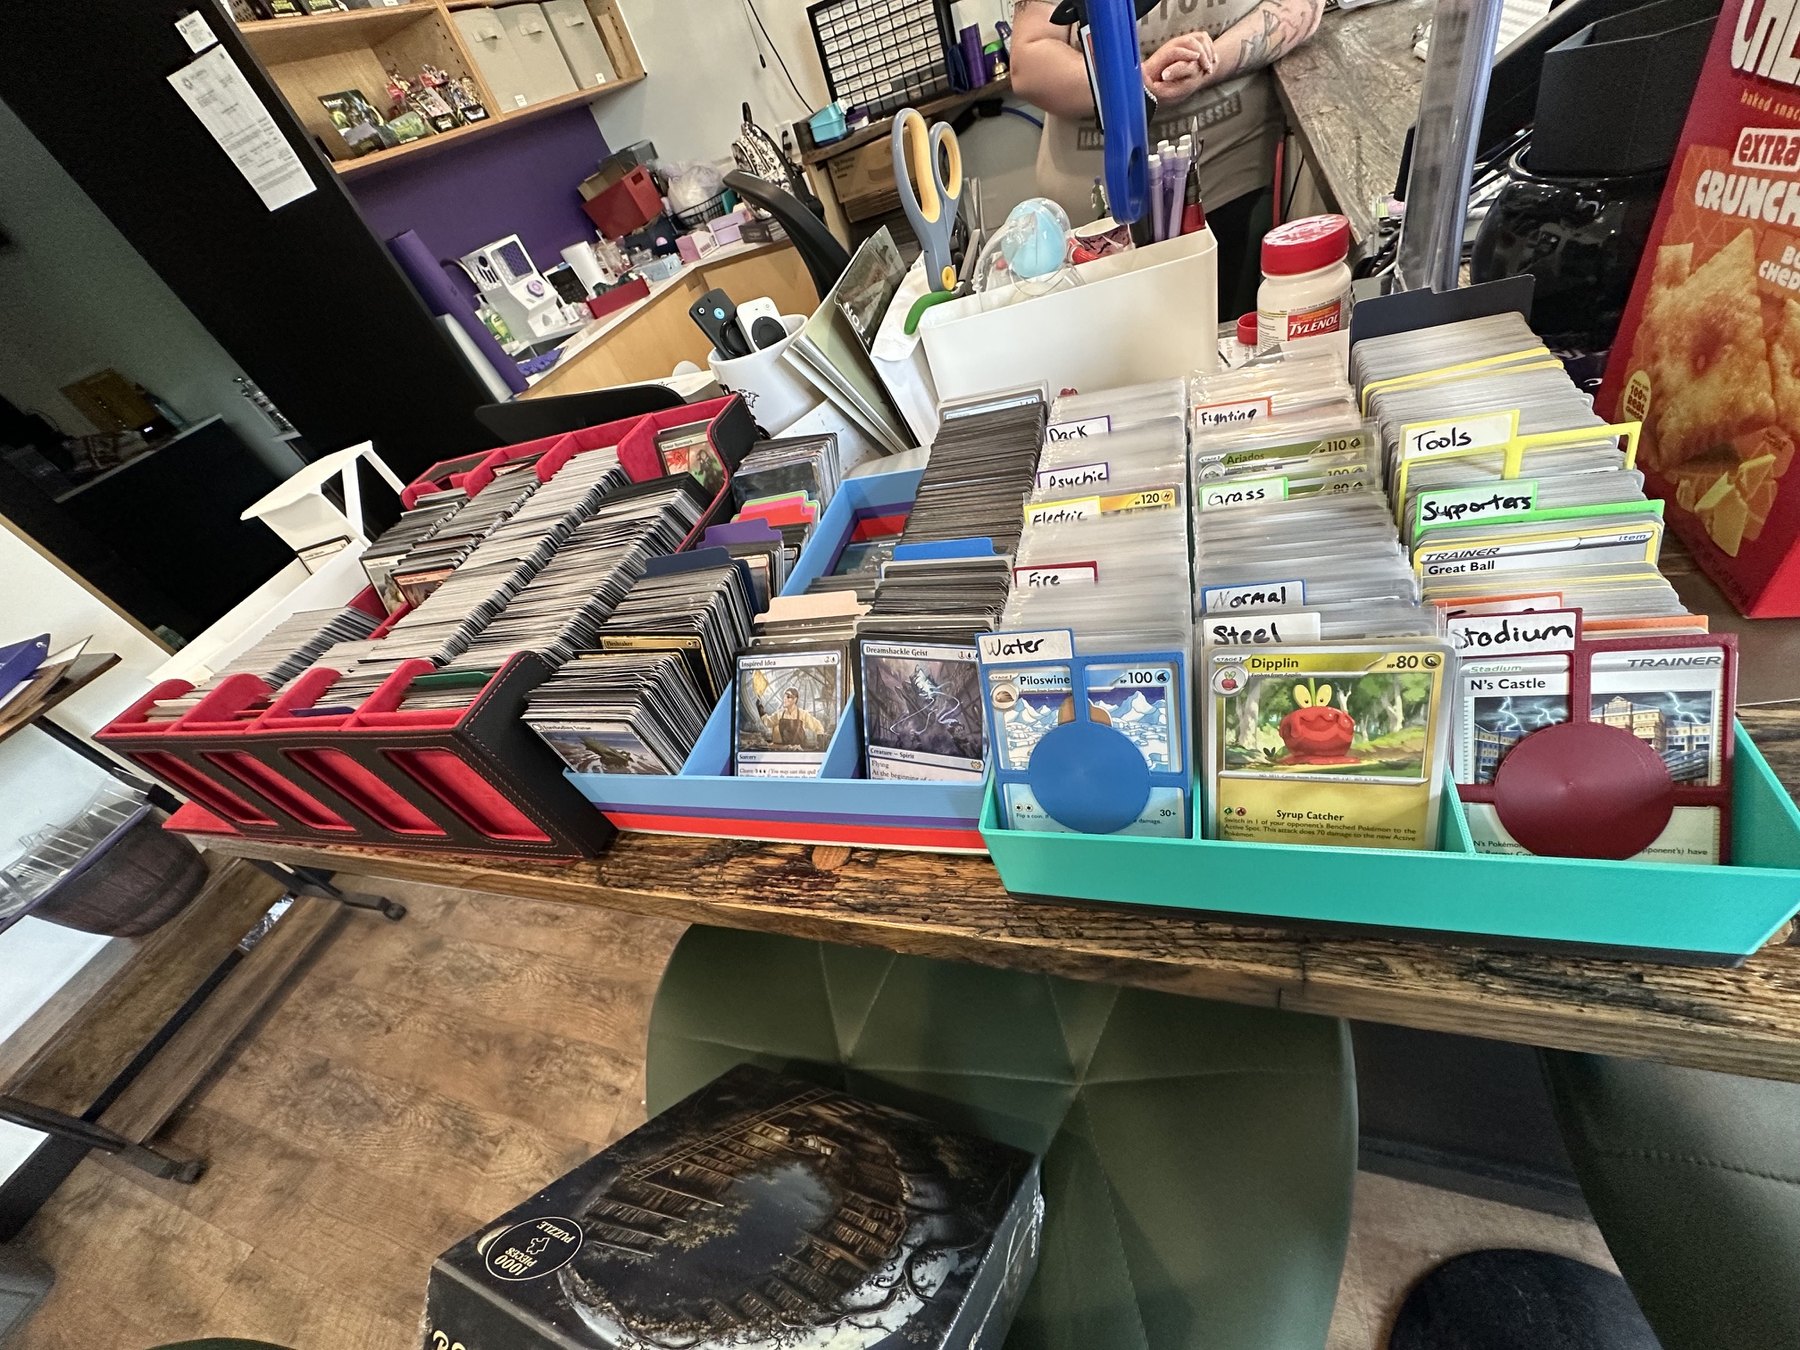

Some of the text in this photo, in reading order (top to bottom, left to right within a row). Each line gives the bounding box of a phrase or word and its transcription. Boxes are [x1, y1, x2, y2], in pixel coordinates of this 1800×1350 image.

[1741, 88, 1773, 112] baked
[1289, 314, 1339, 337] TYLENOL
[1202, 408, 1258, 425] Fighting
[1049, 425, 1089, 442] Dark
[1412, 427, 1472, 451] Tools
[1327, 439, 1347, 452] 110
[1227, 453, 1265, 464] Ariados
[1141, 493, 1160, 504] 120
[1207, 487, 1265, 506] Grass
[1422, 494, 1533, 521] Supporters
[1425, 547, 1501, 561] TRAINER
[1428, 560, 1495, 575] Great Ball
[1029, 572, 1061, 587] Fire
[1213, 586, 1286, 609] Normal
[1212, 622, 1283, 645] Steel
[1451, 619, 1574, 649] Stadium
[866, 646, 910, 656] Dreamshackle
[911, 649, 928, 657] Geist
[983, 638, 1045, 656] Water
[741, 660, 764, 668] Inspired
[1251, 658, 1299, 671] Dipplin
[1396, 655, 1419, 669] 80
[1470, 656, 1722, 673] Stadium TRAINER
[1020, 675, 1070, 685] Piloswine
[1128, 671, 1153, 684] 100
[1470, 678, 1546, 691] N's Castle
[871, 760, 889, 769] Flying
[1276, 809, 1344, 821] Syrup Catcher
[1286, 821, 1324, 829] opponent's
[1326, 823, 1356, 831] Benched
[1488, 840, 1522, 848] Pokémo
[1687, 848, 1708, 856] have
[536, 1220, 576, 1244] PUZZLE
[493, 1254, 529, 1276] 1000
[505, 1247, 538, 1268] PIECES
